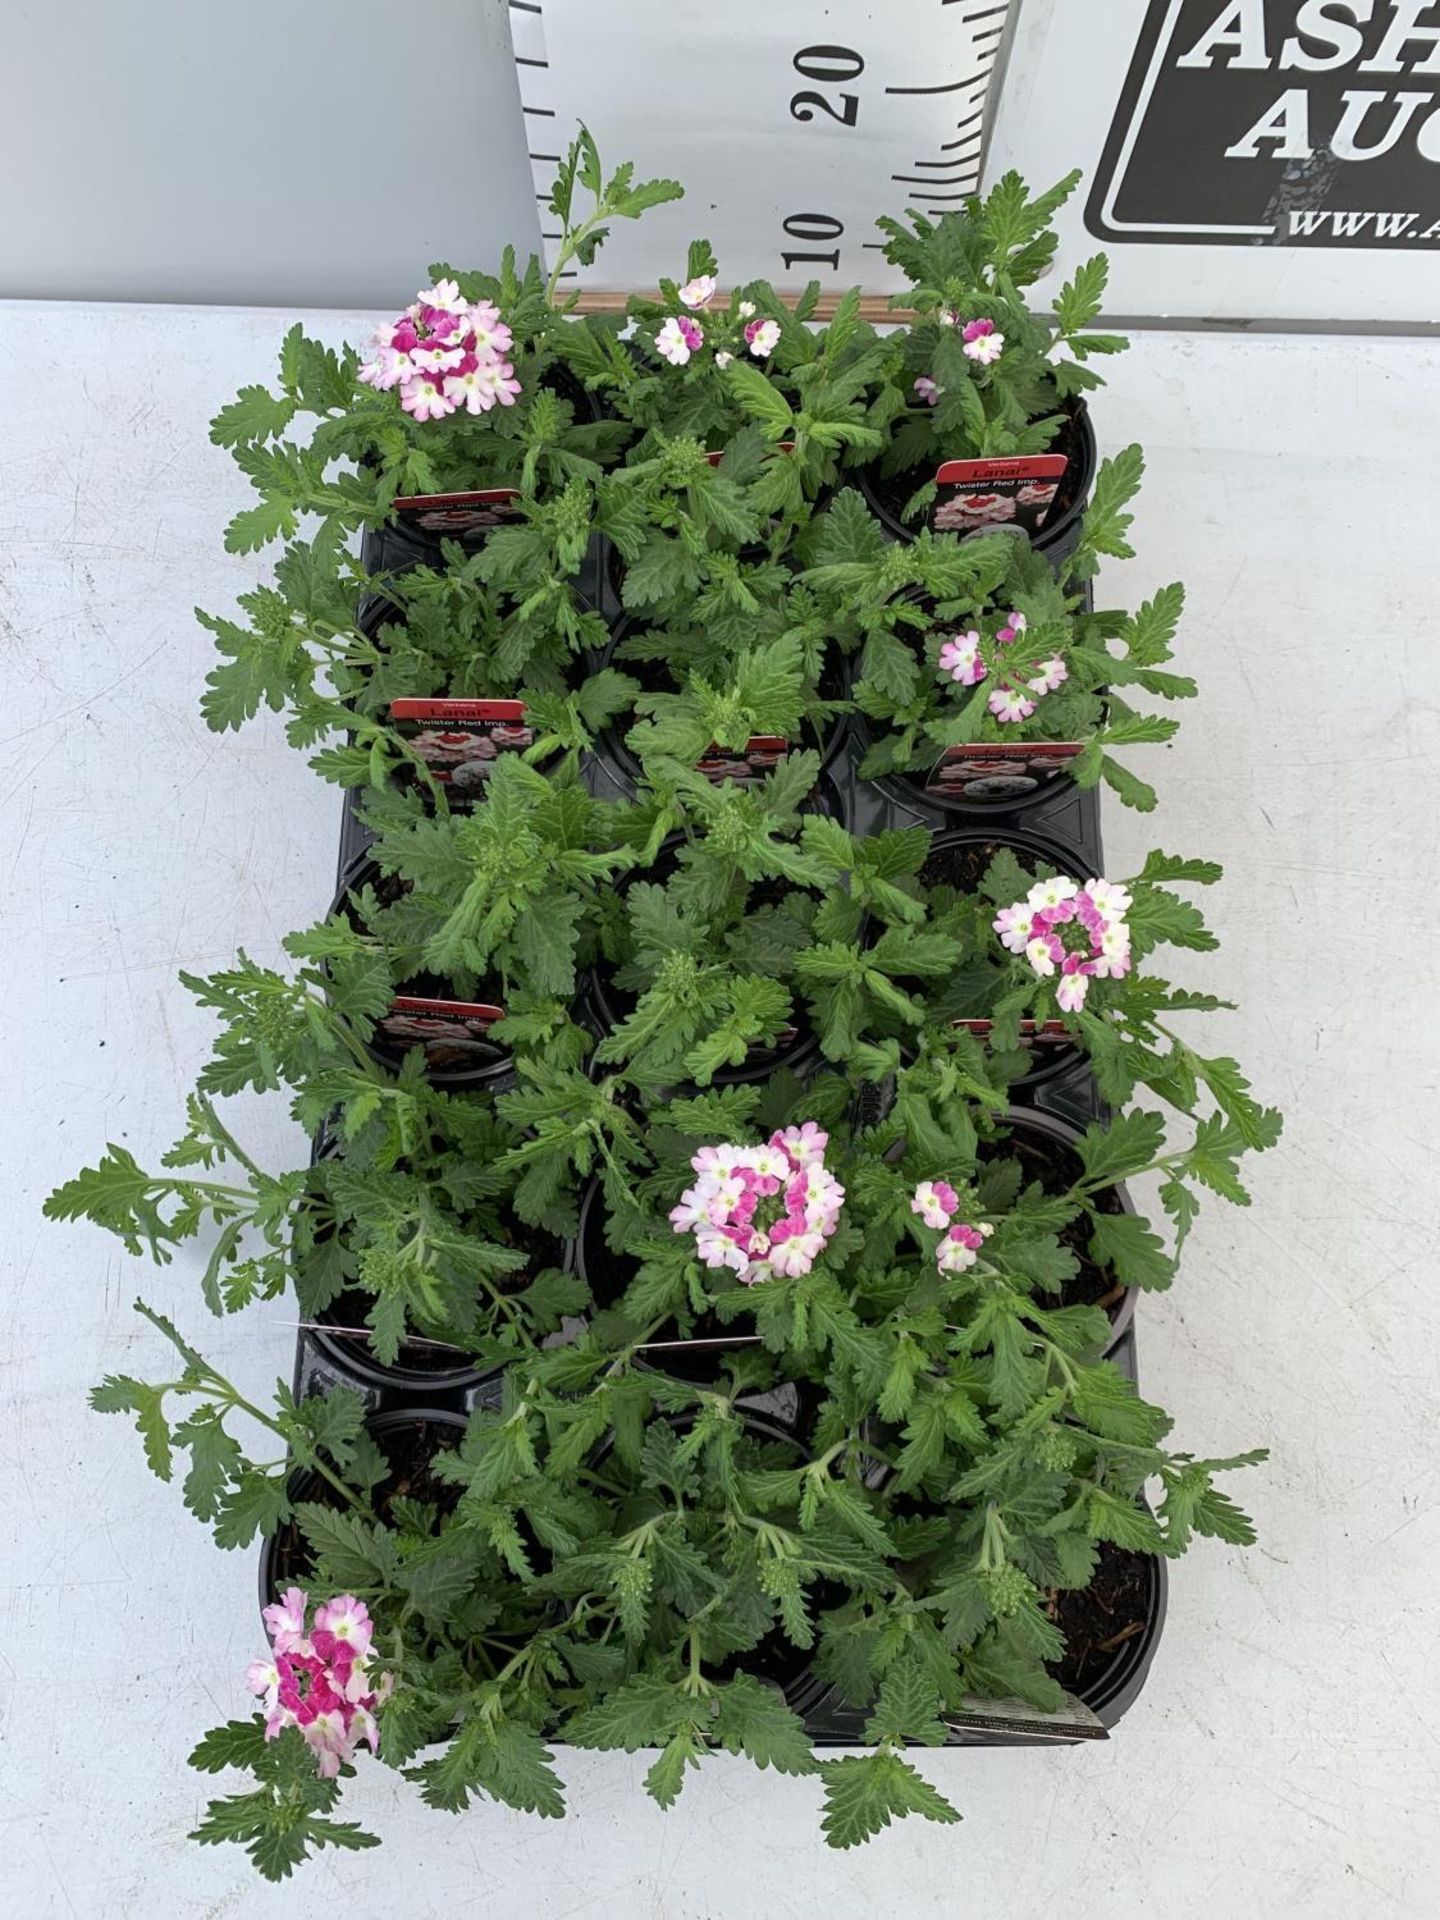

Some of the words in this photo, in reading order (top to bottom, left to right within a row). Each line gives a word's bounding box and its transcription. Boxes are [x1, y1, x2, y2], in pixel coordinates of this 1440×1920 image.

[1176, 0, 1440, 73] ASH
[790, 45, 865, 127] 20
[1224, 89, 1440, 163] AU
[781, 213, 844, 271] 10
